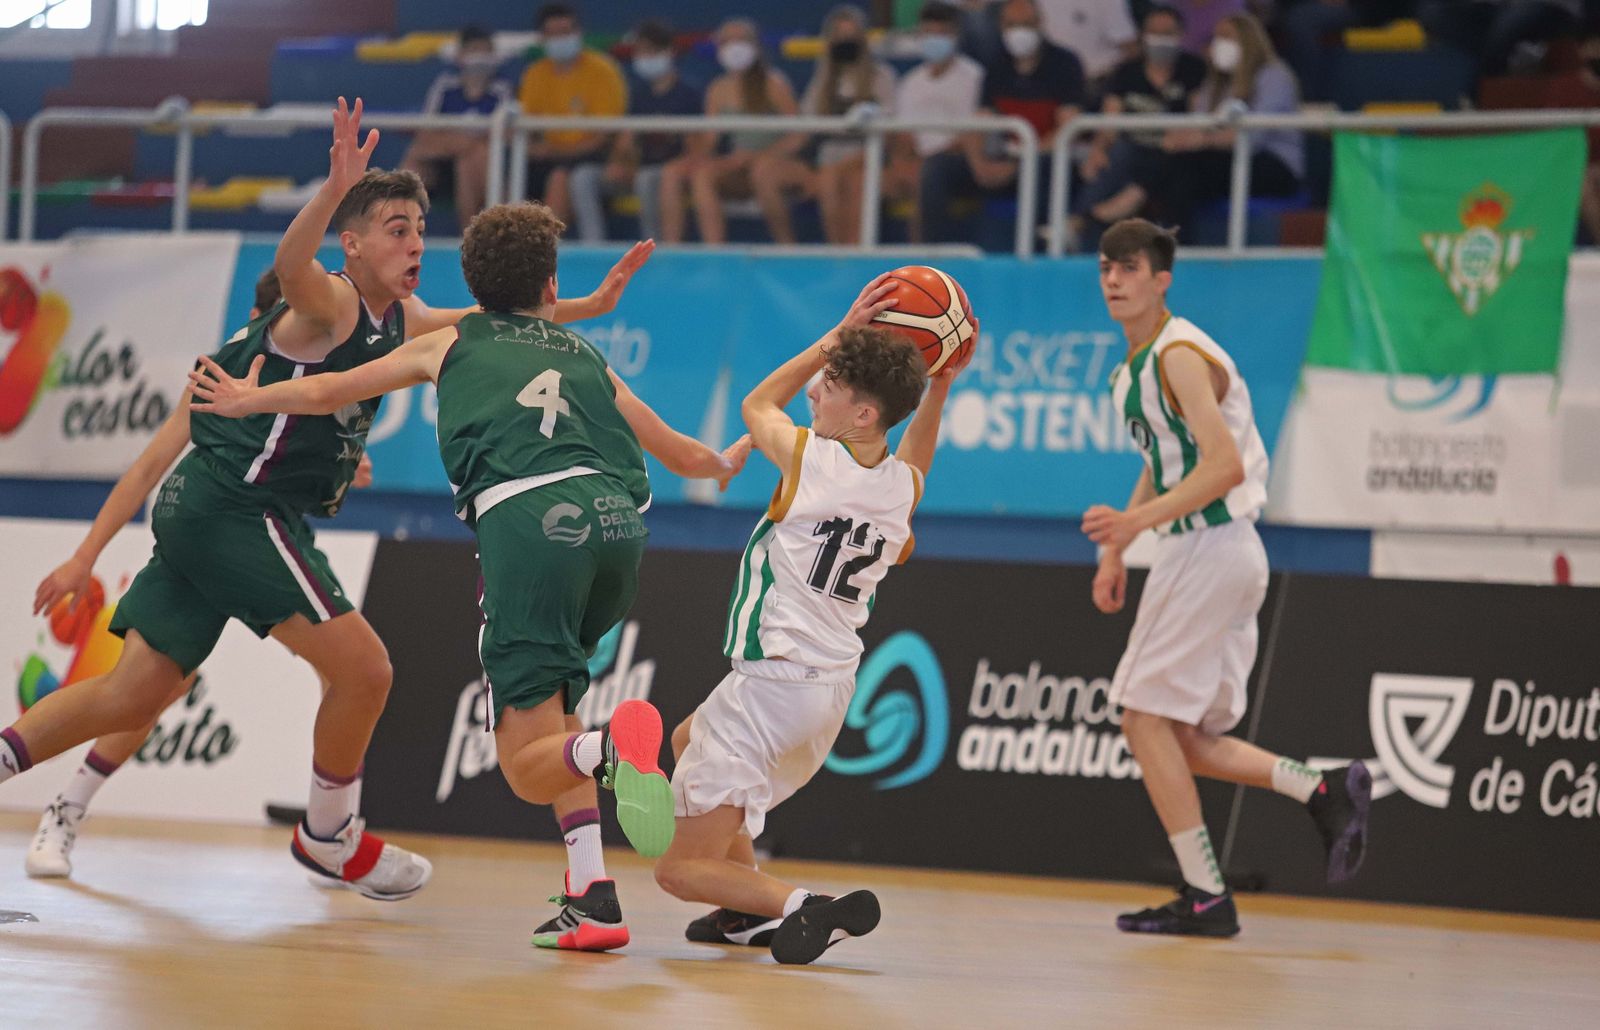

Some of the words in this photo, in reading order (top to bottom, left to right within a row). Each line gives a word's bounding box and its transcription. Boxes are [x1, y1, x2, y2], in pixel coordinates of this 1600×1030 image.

[960, 331, 1118, 389] ASKET
[515, 368, 571, 439] 4
[599, 512, 627, 528] DEL
[806, 516, 887, 605] 12
[1468, 756, 1525, 814] de
[1540, 761, 1600, 819] Cá
